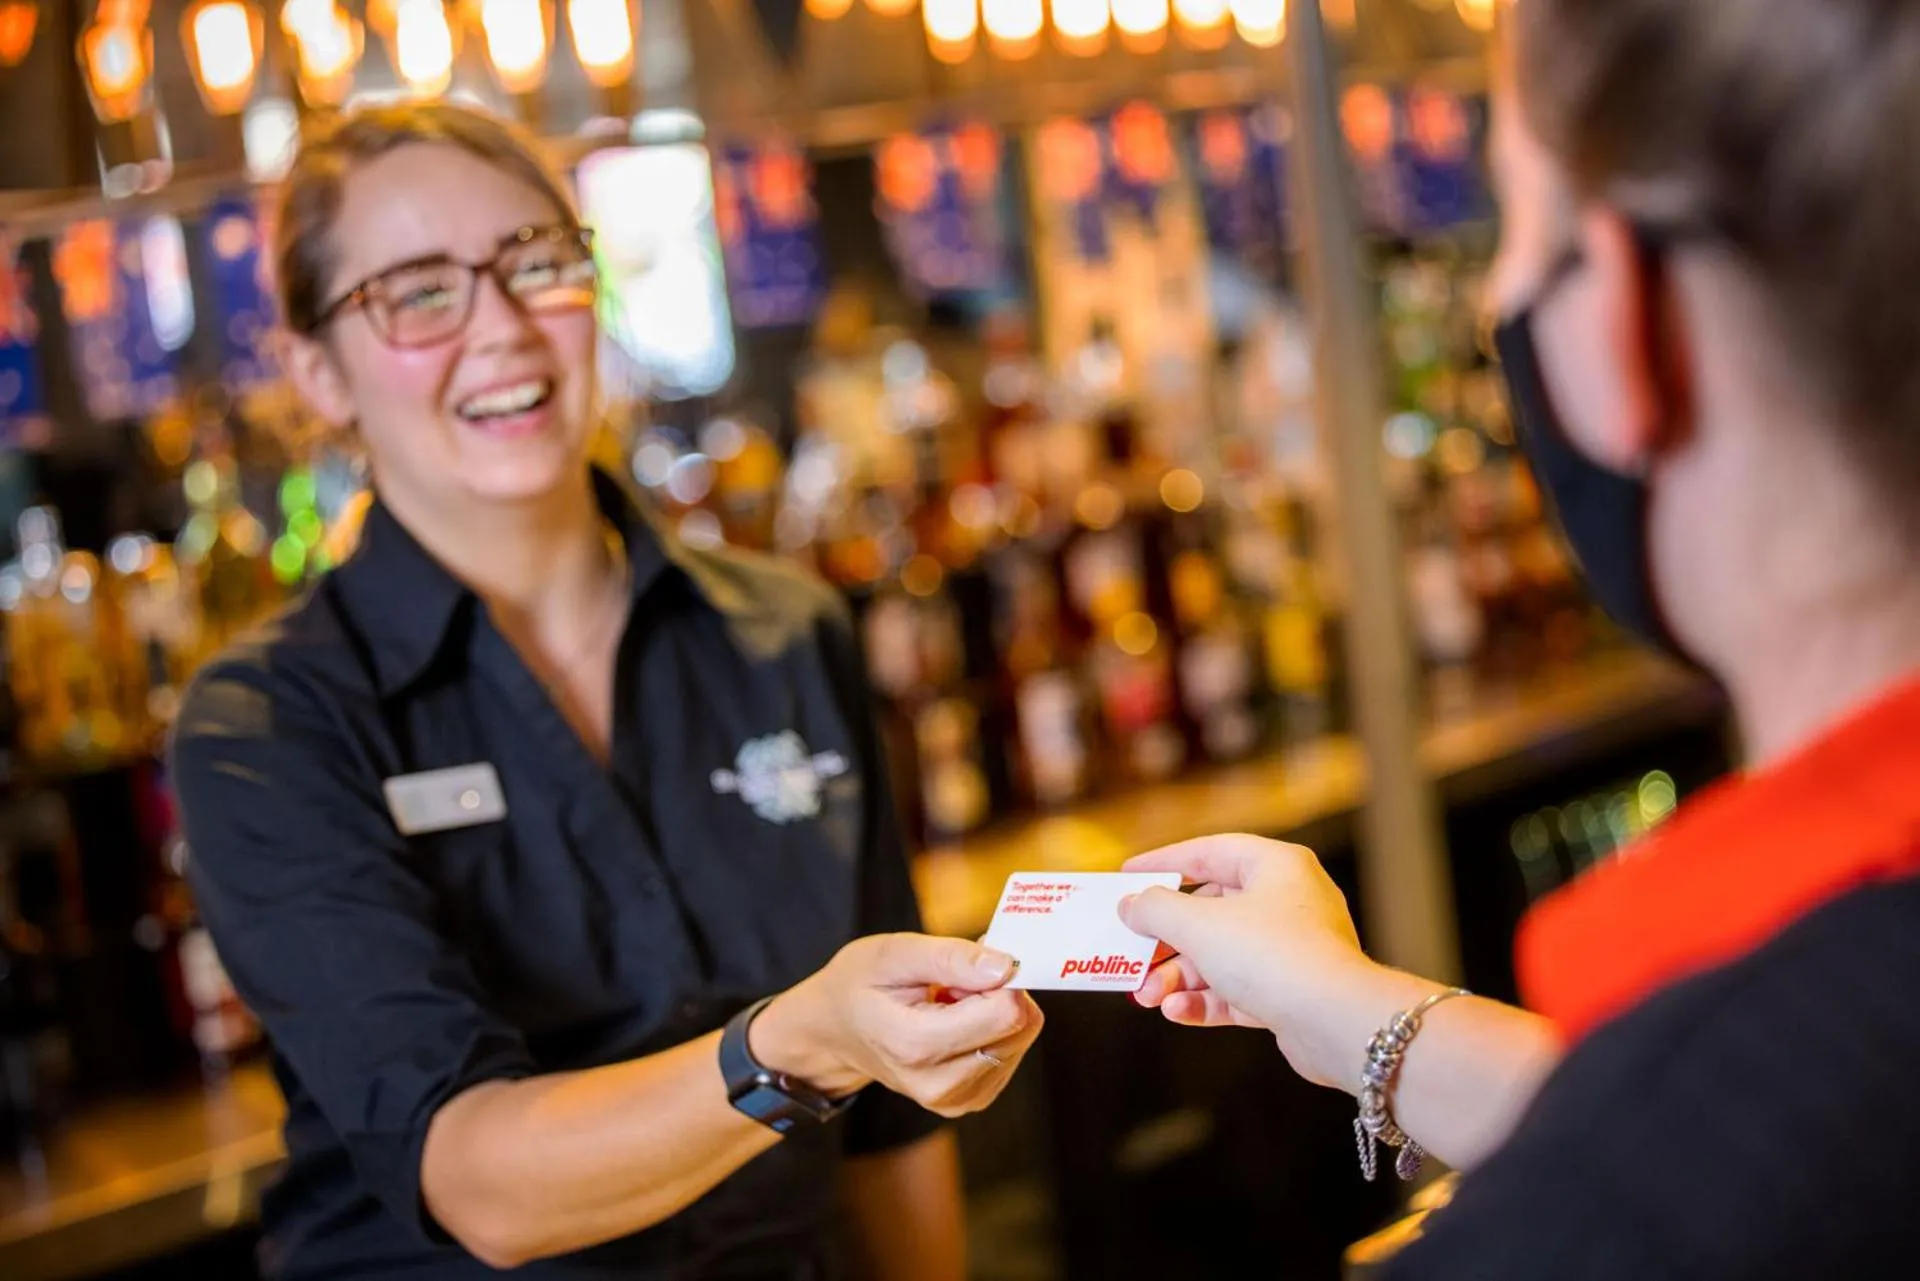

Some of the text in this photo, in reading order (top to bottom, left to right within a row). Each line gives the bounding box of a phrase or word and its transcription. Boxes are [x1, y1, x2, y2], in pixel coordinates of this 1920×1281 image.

[1012, 881, 1072, 893] Together we
[1027, 892, 1054, 903] make
